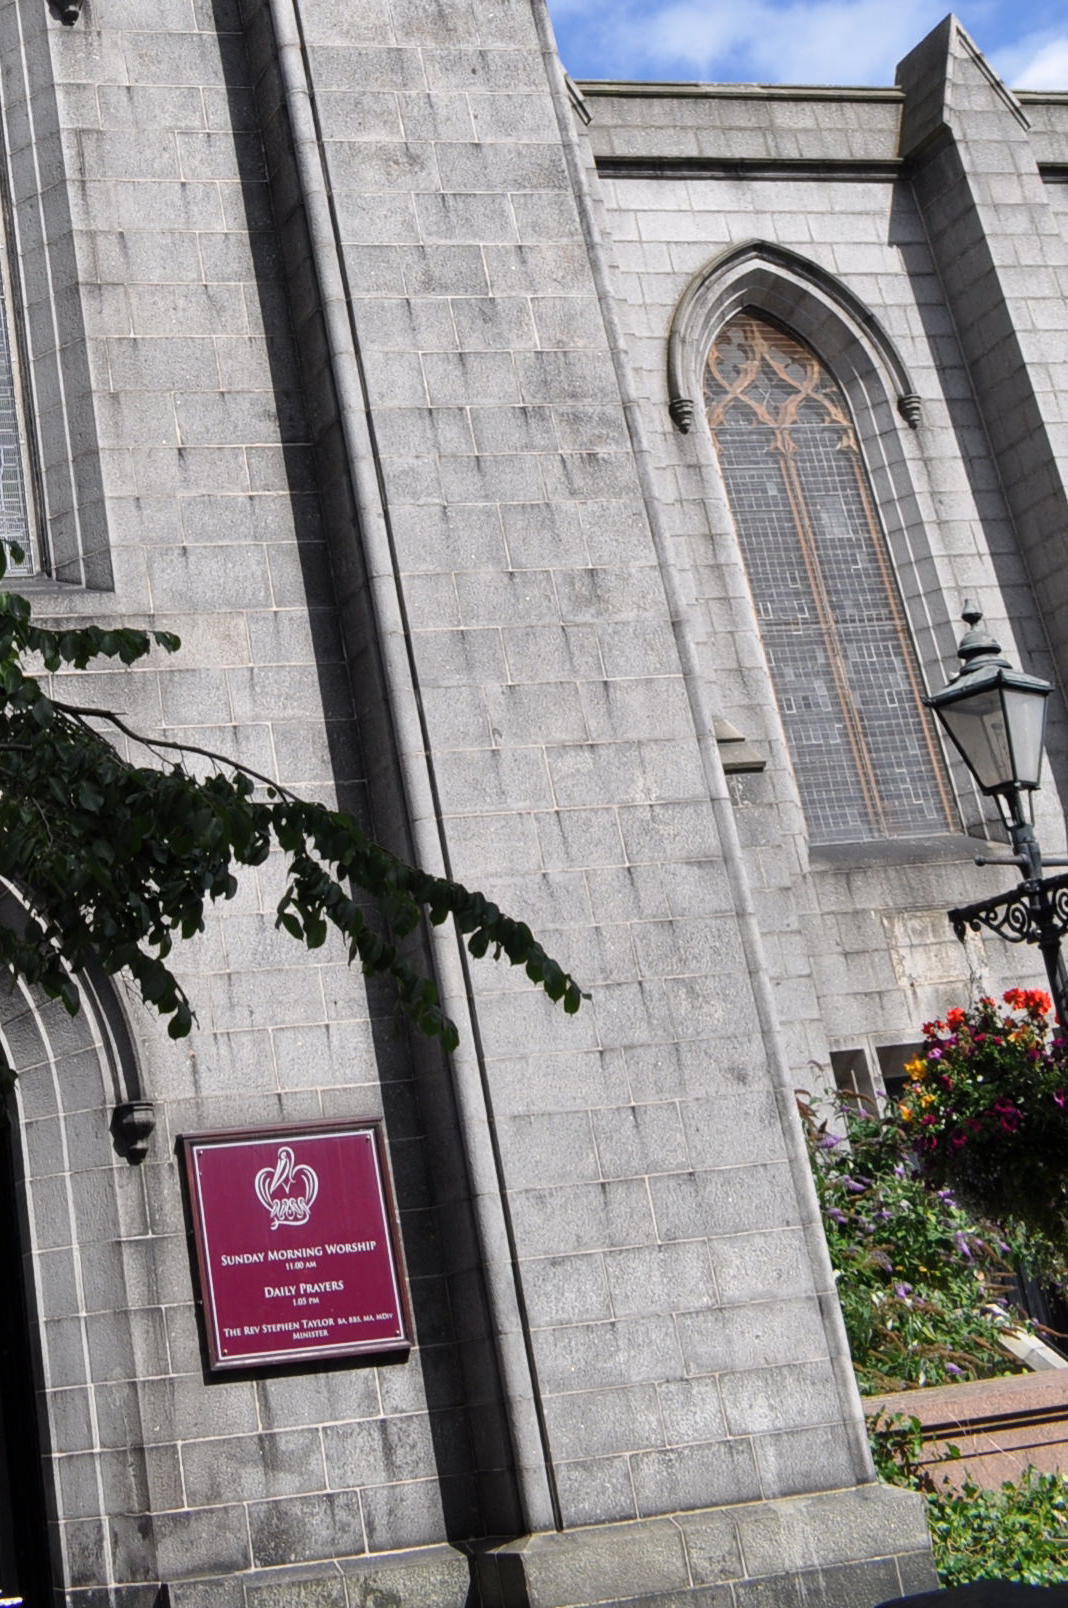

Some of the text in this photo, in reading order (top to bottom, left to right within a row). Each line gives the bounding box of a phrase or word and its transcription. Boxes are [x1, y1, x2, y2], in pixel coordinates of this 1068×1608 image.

[221, 1241, 377, 1266] SUNDAY MORNING WORSHIP
[285, 1261, 317, 1271] 11.00 AM
[264, 1280, 344, 1298] DAILY PRAYERS
[293, 1296, 320, 1306] 1.05 PM
[223, 1328, 242, 1338] THE
[244, 1325, 261, 1336] REV
[262, 1321, 300, 1333] STEPHEN
[302, 1318, 335, 1330] TAYLOR
[292, 1329, 329, 1340] MINISTER
